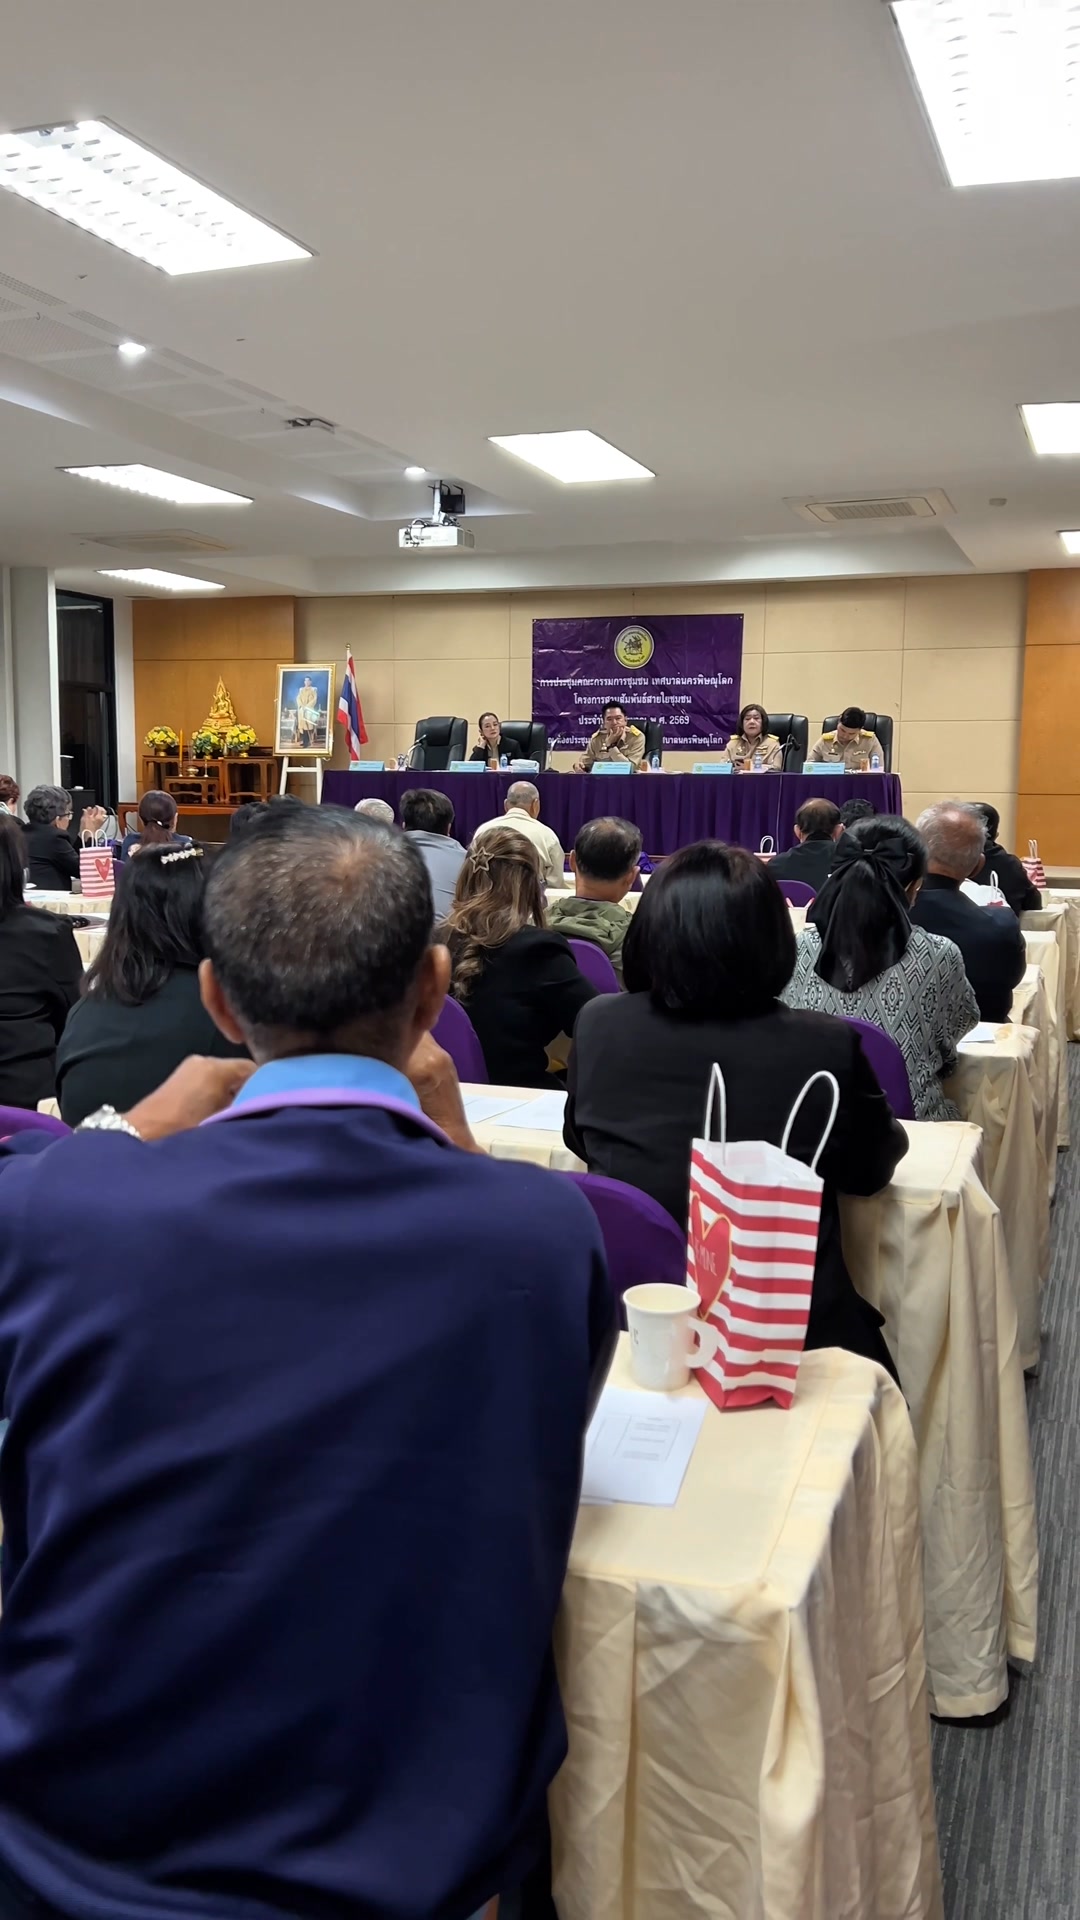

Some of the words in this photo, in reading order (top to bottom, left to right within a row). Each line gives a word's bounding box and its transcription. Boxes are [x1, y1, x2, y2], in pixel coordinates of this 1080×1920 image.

[651, 673, 733, 689] เทศบาลนครพิษณุโลก
[669, 715, 690, 725] 2569
